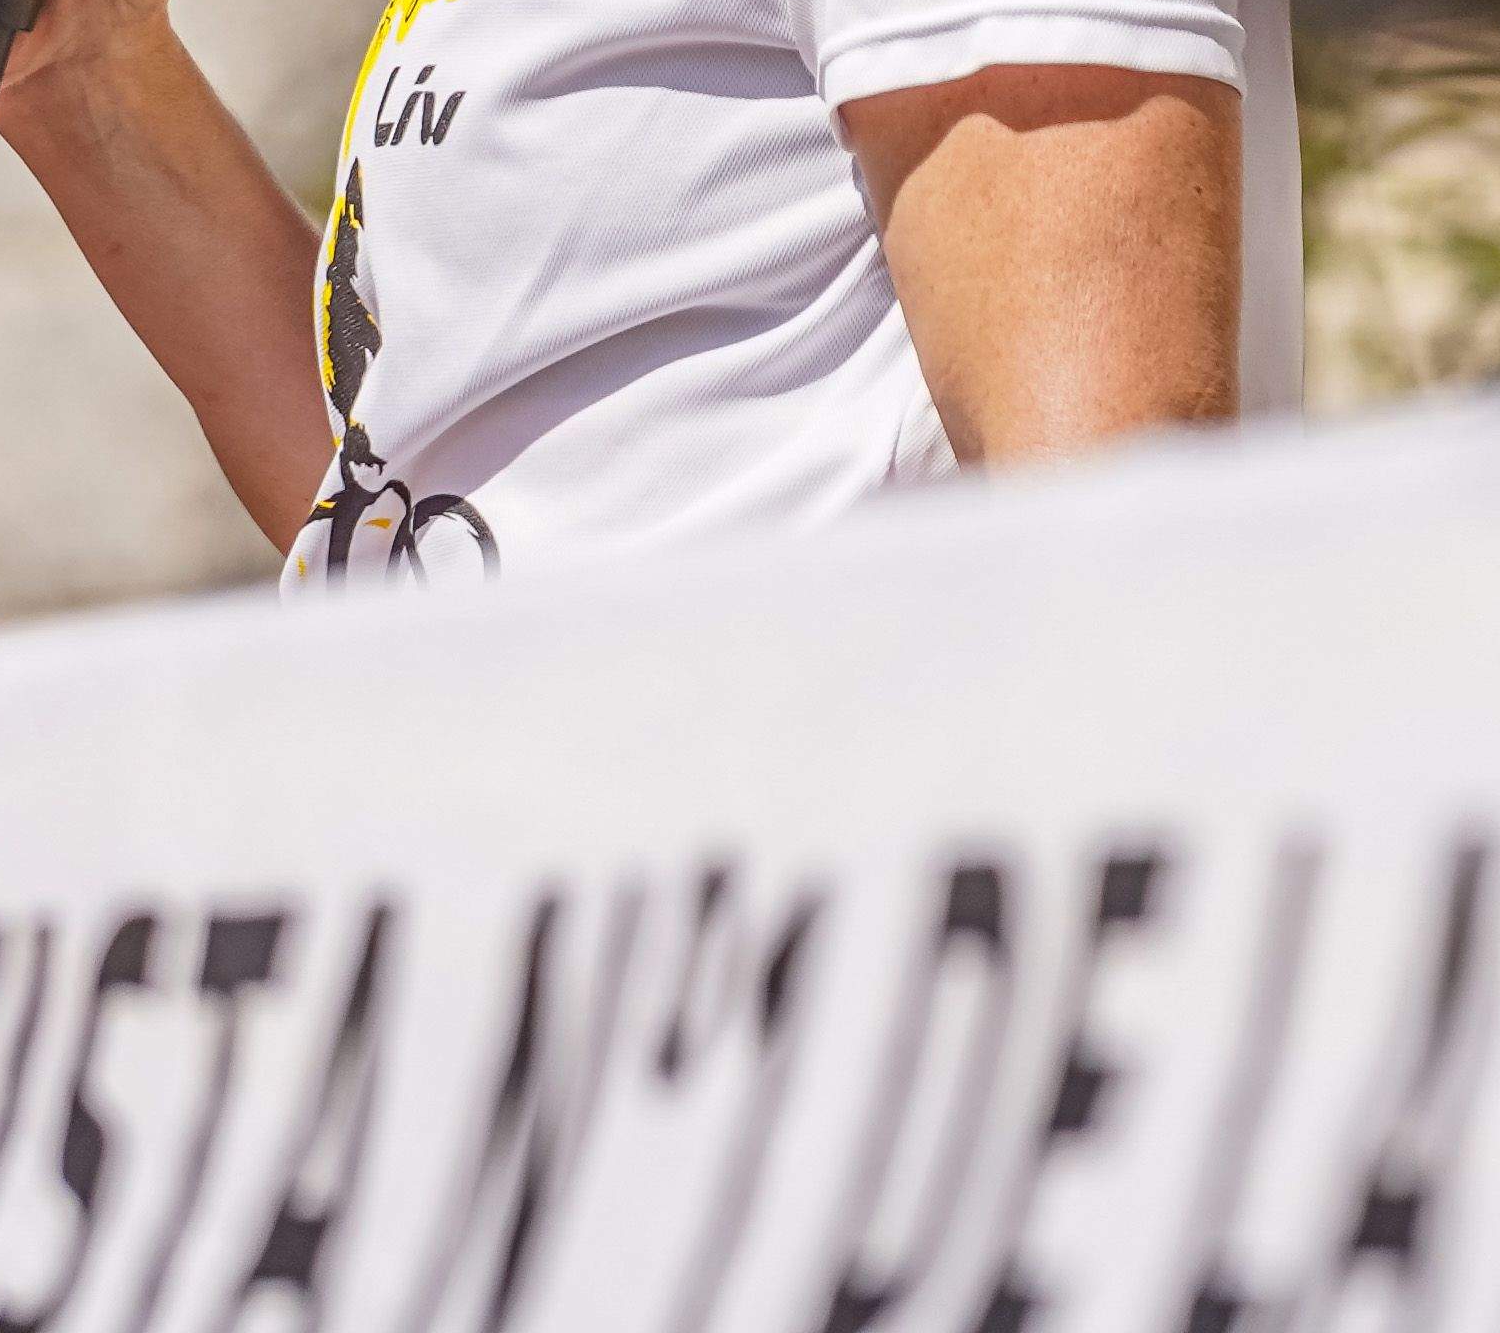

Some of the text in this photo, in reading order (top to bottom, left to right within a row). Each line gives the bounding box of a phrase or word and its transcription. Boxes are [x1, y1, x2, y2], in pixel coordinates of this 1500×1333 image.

[373, 64, 466, 148] Liv
[822, 845, 1168, 1333] DE
[1185, 830, 1498, 1333] LA
